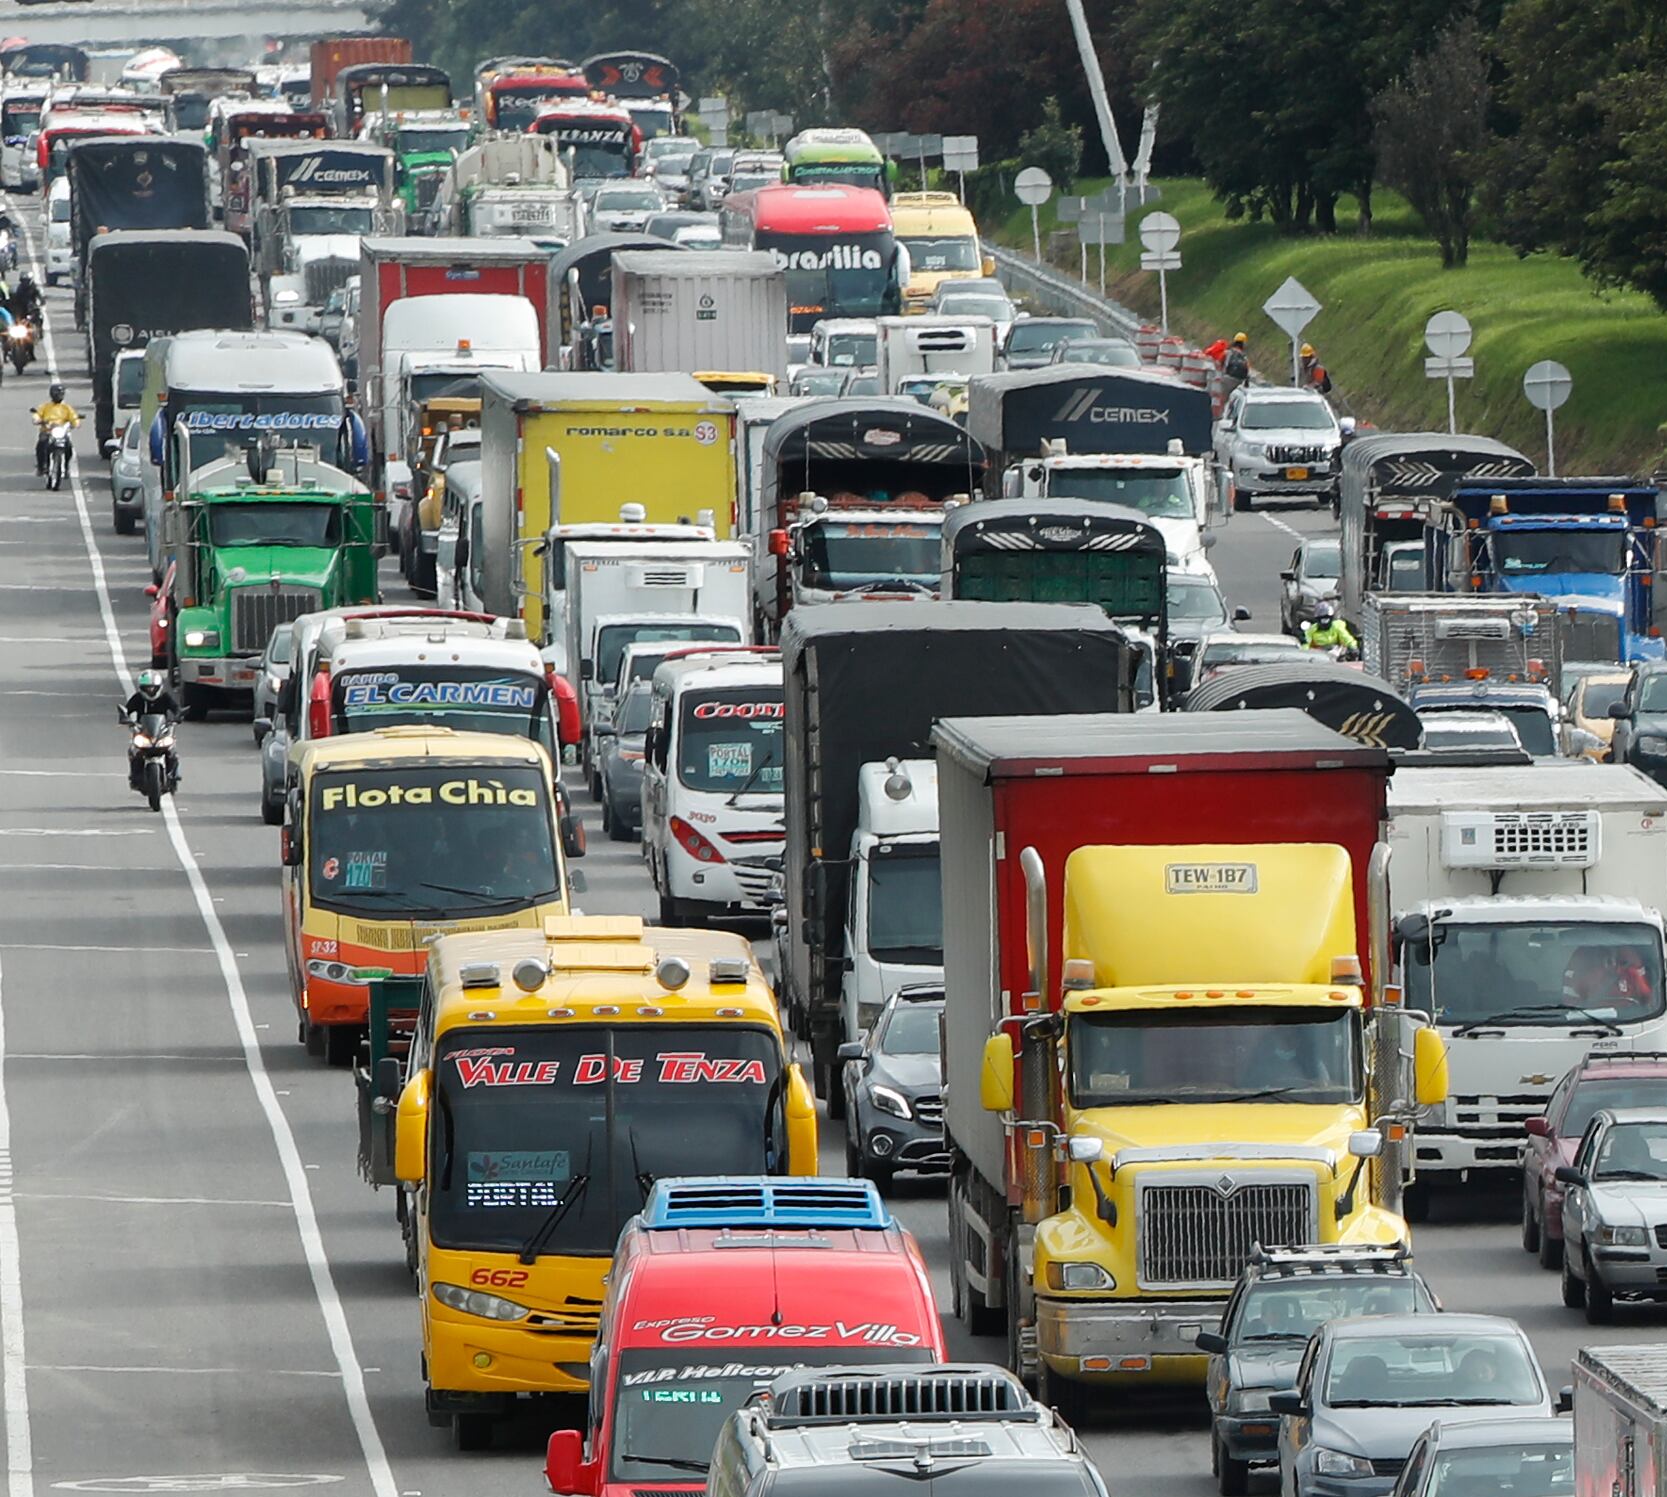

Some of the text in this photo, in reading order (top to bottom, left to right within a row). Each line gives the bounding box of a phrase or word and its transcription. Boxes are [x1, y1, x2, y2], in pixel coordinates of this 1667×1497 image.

[1090, 407, 1170, 424] CEMEX
[566, 427, 659, 437] romarco
[345, 682, 536, 709] EL CARMEN
[322, 784, 433, 810] Flota
[455, 1051, 768, 1090] VALLE DE TENZA
[471, 1267, 530, 1289] 662
[633, 1316, 717, 1331] Expreso
[660, 1321, 921, 1346] Gomez Villa
